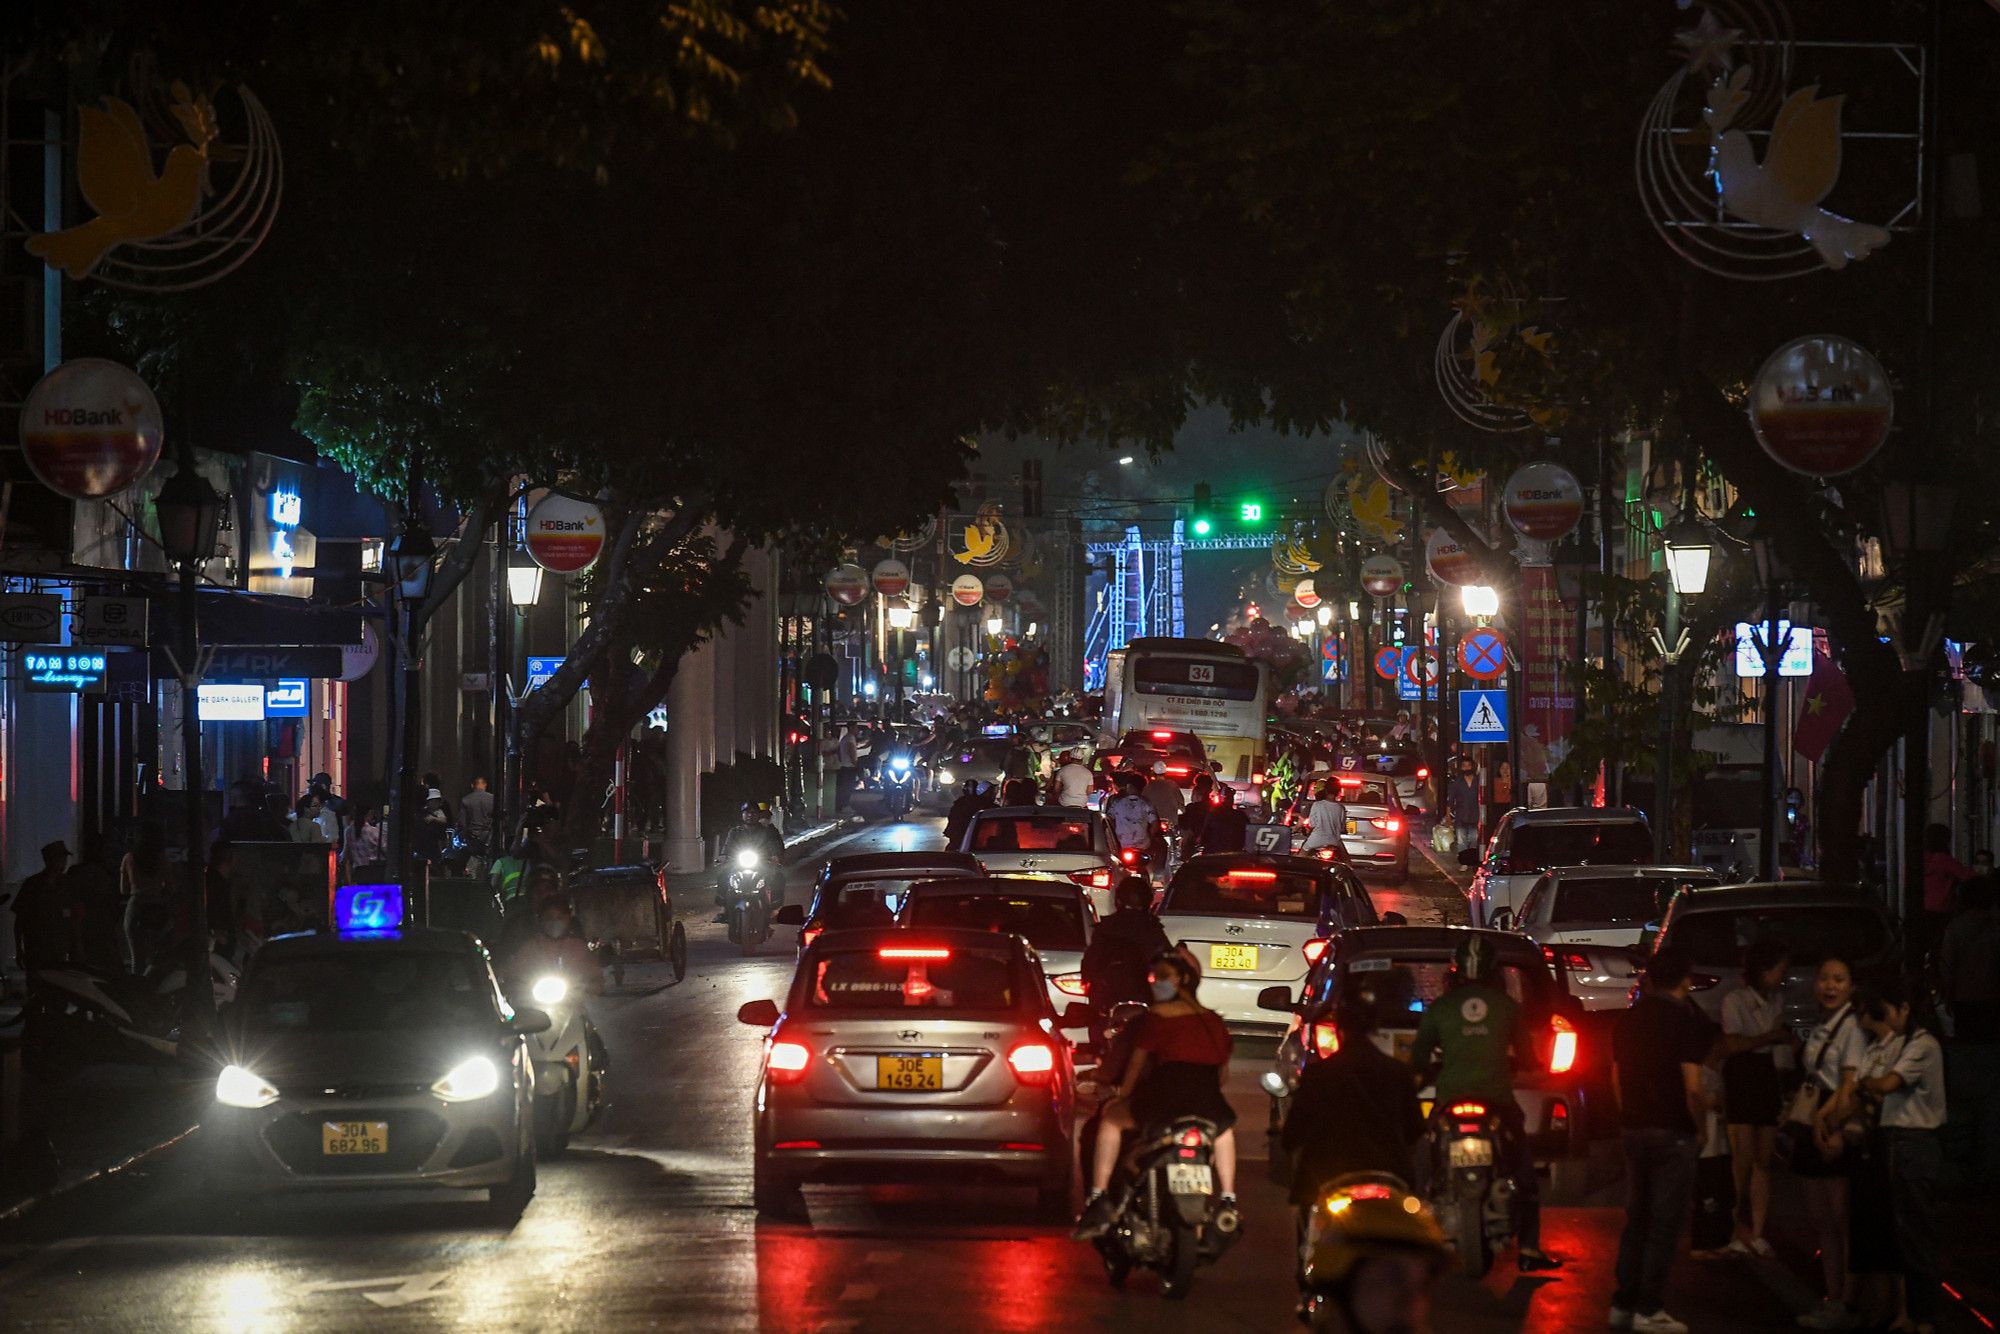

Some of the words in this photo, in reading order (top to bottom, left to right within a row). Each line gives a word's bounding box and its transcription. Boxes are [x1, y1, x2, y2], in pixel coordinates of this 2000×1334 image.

[44, 408, 123, 426] HDBank
[1517, 489, 1562, 500] HDBank
[1242, 504, 1261, 520] 30
[540, 520, 585, 531] HDBank
[1436, 544, 1463, 556] HDBa
[25, 656, 62, 670] TAM
[67, 656, 105, 670] SON
[1192, 667, 1210, 680] 34
[231, 696, 259, 704] GALLERY
[1225, 947, 1244, 957] 30A
[1216, 958, 1252, 969] 823.40
[897, 1059, 924, 1072] 30E
[887, 1074, 935, 1090] 149.24
[341, 1123, 368, 1138] 30A
